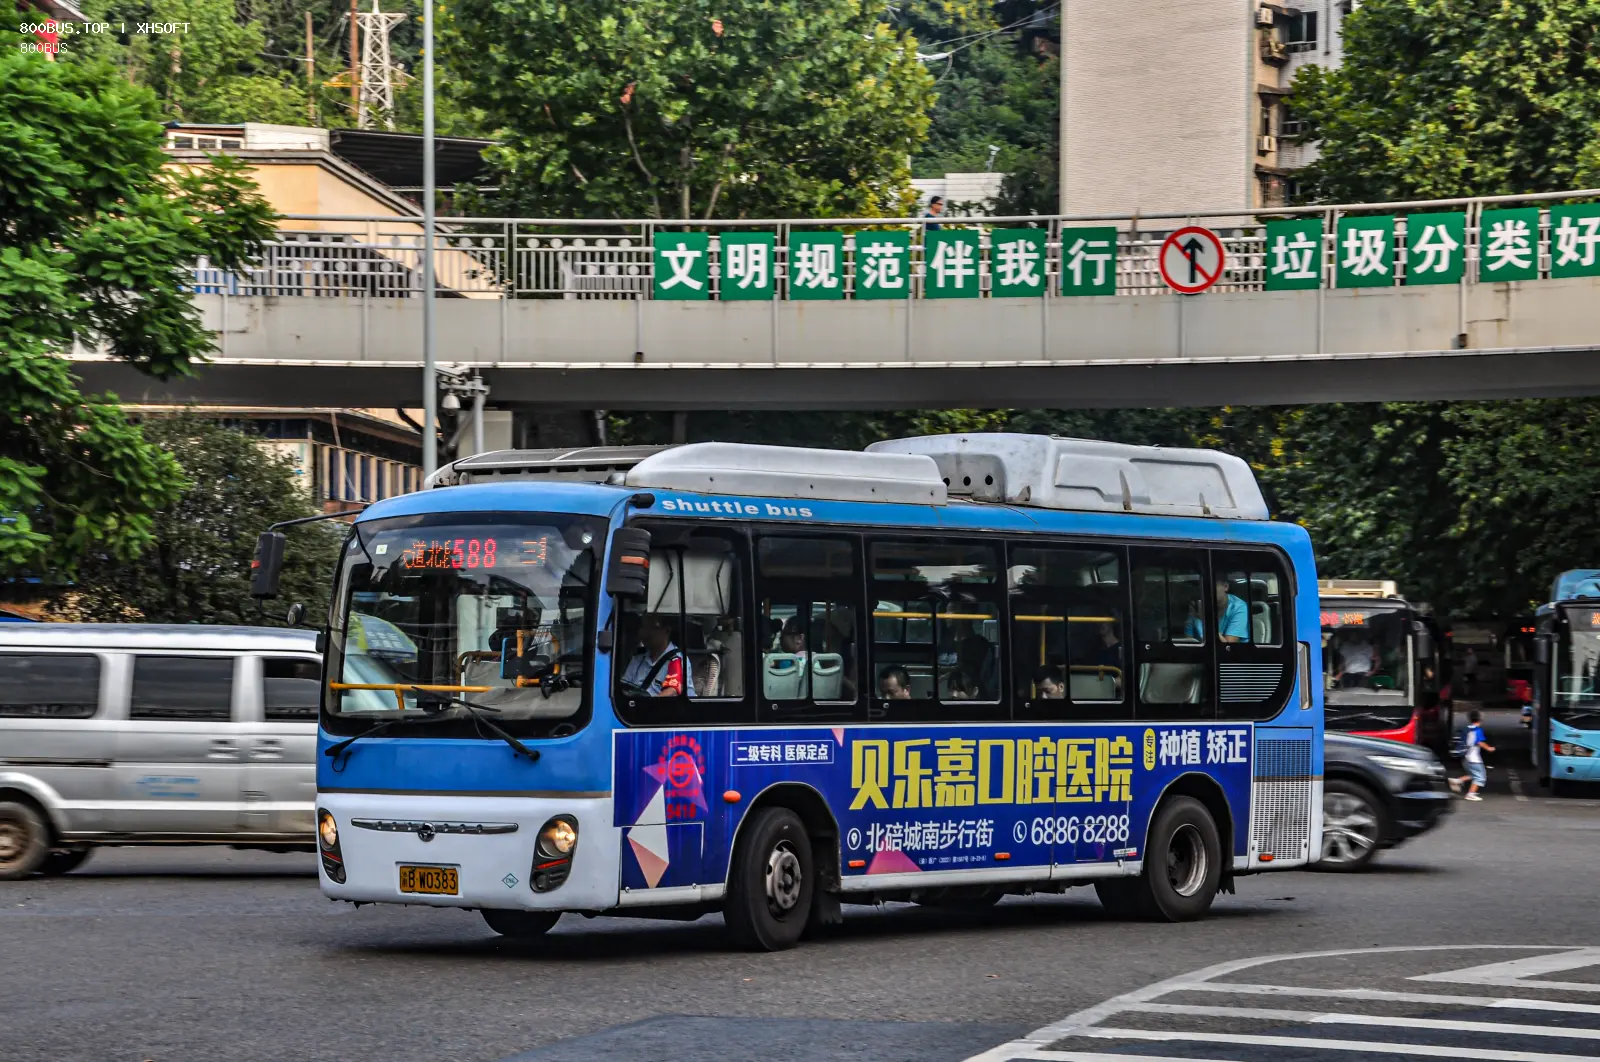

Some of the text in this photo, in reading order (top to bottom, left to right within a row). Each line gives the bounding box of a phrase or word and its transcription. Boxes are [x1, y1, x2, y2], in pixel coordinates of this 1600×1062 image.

[659, 237, 1112, 290] 文明规范伴我行
[1271, 216, 1600, 279] 垃圾分类好
[662, 498, 813, 518] shuttle bus
[452, 538, 497, 568] 588
[737, 744, 829, 762] 二级专科 医保定点
[1160, 729, 1247, 765] 种植 矫正
[849, 735, 1133, 810] 贝乐嘉口腔医院
[865, 819, 994, 852] 北碚城南步行街
[1031, 814, 1130, 845] 6886 8288
